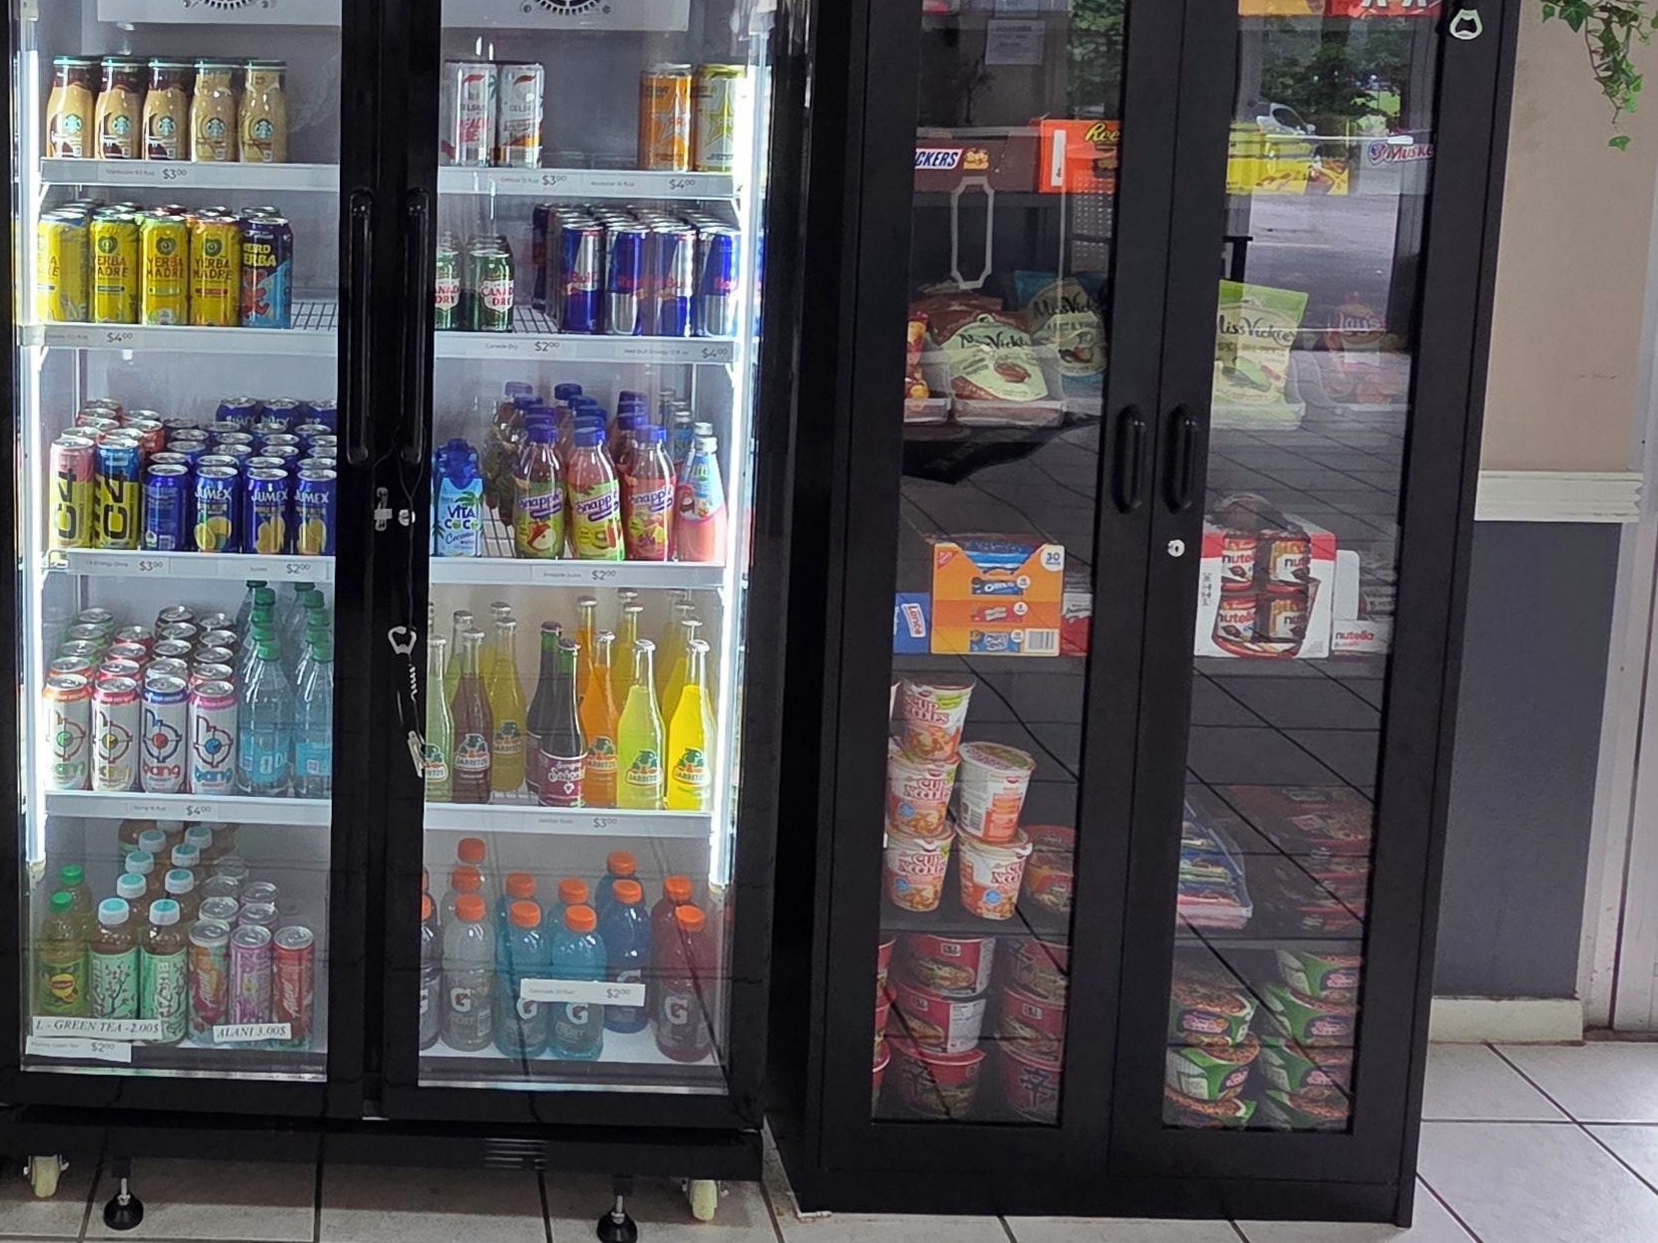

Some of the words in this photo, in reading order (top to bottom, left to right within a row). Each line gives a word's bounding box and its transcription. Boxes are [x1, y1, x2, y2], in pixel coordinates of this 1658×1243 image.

[195, 259, 230, 268] YERBA
[195, 487, 232, 500] JUMEX
[251, 488, 288, 502] JUMEX
[294, 489, 330, 503] JUMEX
[448, 506, 476, 519] VITA
[1046, 552, 1060, 561] 30
[1335, 630, 1374, 640] nutella
[451, 988, 471, 1012] G
[565, 1003, 589, 1025] G
[664, 995, 688, 1024] G
[54, 1020, 96, 1031] GREEN
[100, 1021, 122, 1032] TEA
[217, 1029, 254, 1038] ALANI
[257, 1026, 286, 1037] 3.00$
